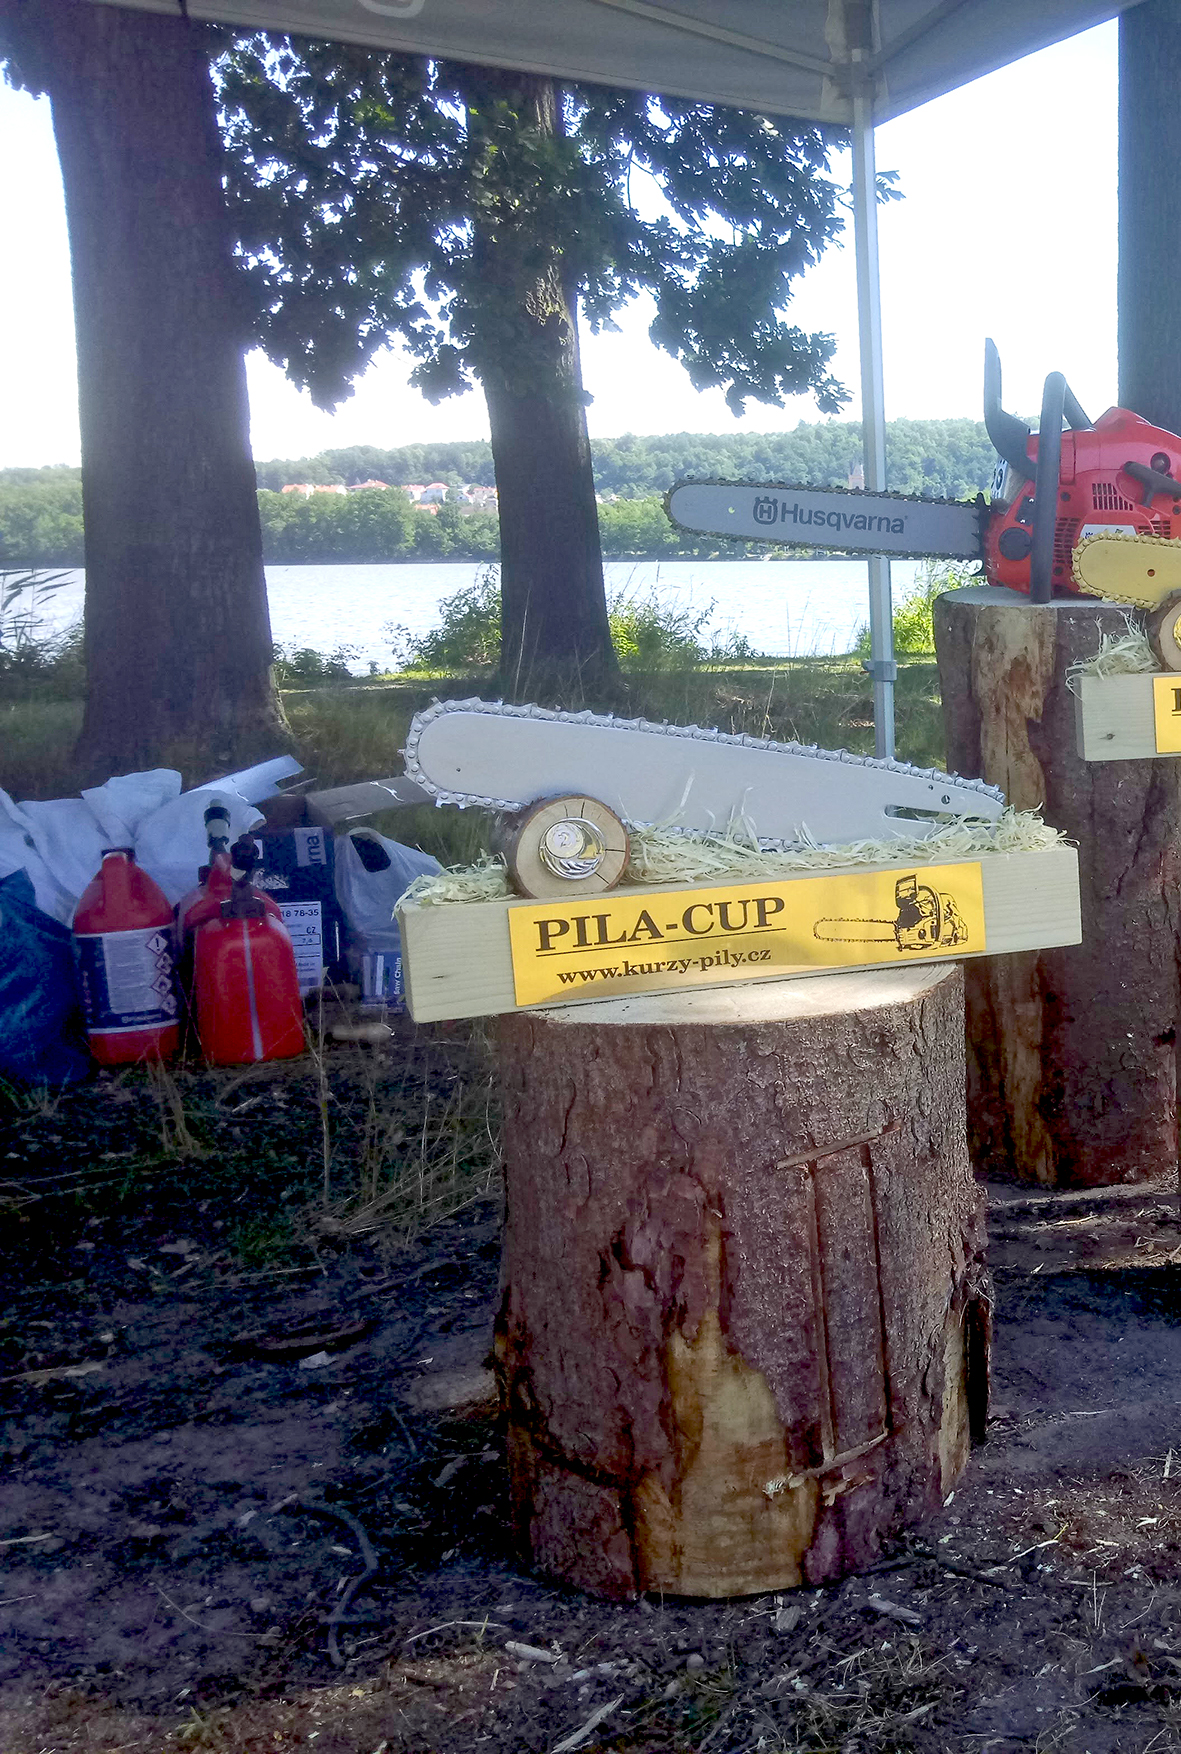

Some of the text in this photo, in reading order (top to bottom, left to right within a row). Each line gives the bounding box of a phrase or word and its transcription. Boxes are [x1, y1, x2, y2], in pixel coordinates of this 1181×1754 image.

[780, 502, 905, 534] Husqvarna
[534, 896, 786, 952] PILA-CUP
[556, 949, 772, 985] www.kurzy-pily.cz
